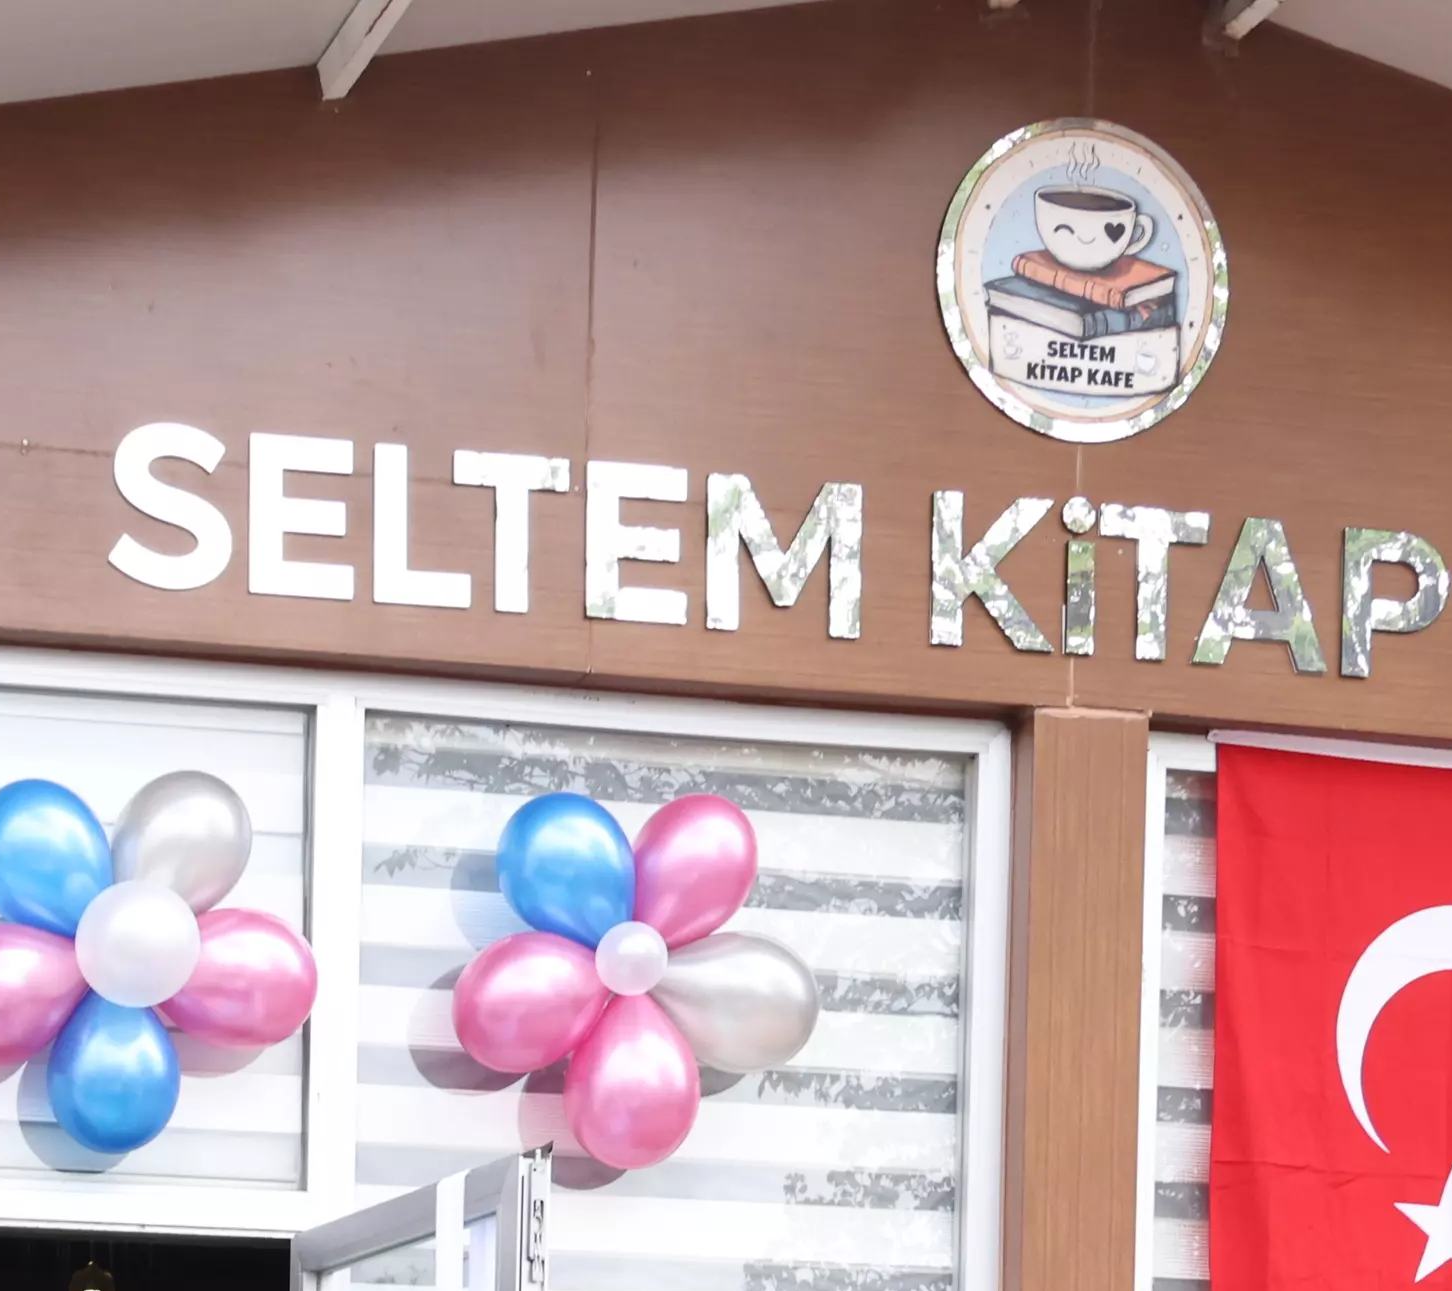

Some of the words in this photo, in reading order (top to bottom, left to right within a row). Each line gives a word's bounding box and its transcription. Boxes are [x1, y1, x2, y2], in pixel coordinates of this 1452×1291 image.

[1047, 340, 1116, 364] SELTEM
[1026, 358, 1083, 384] KİTAP
[1087, 368, 1135, 389] KAFE
[108, 422, 863, 640] SELTEM
